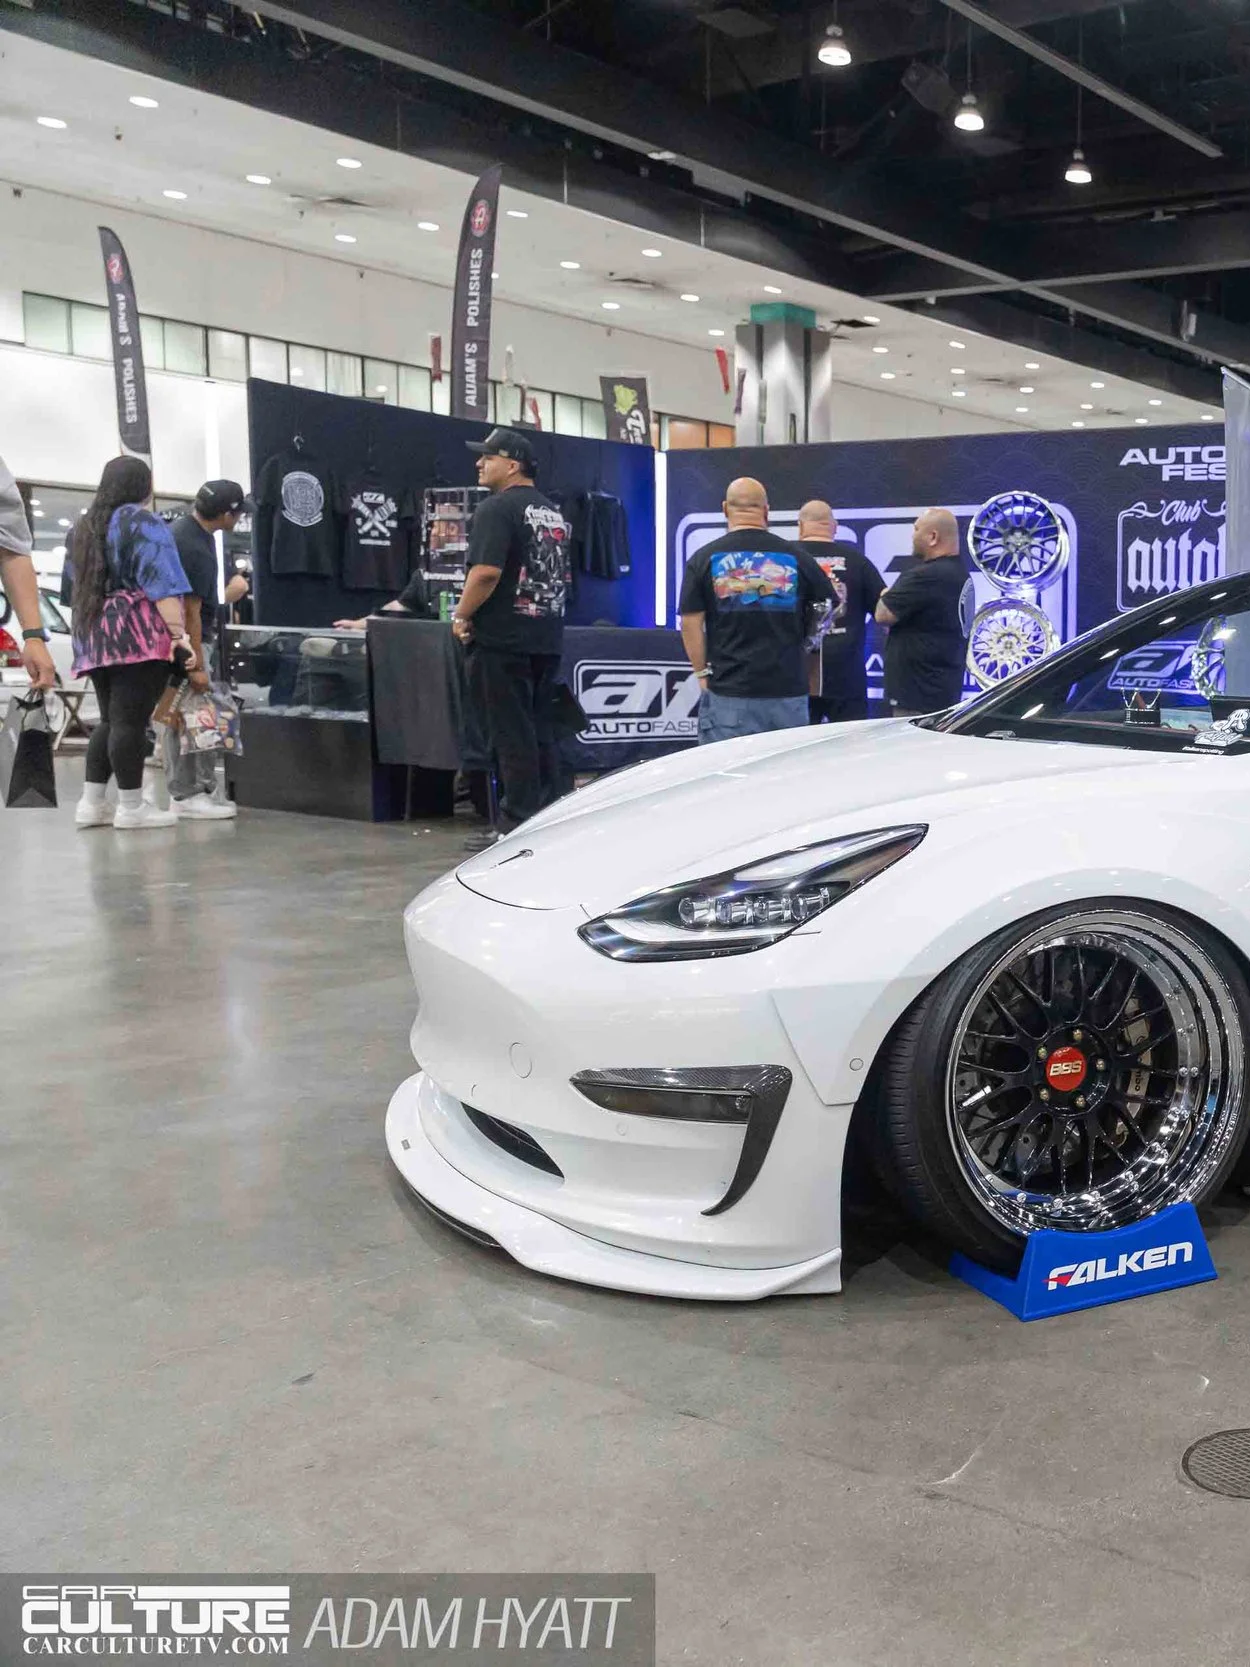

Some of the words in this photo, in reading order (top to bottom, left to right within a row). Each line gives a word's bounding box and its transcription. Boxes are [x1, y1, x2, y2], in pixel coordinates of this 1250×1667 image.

[466, 248, 484, 327] POLISHES
[122, 357, 138, 424] POLISHES
[1161, 500, 1202, 526] Club
[1050, 1060, 1082, 1076] BBS
[1045, 1241, 1193, 1291] FALKEN
